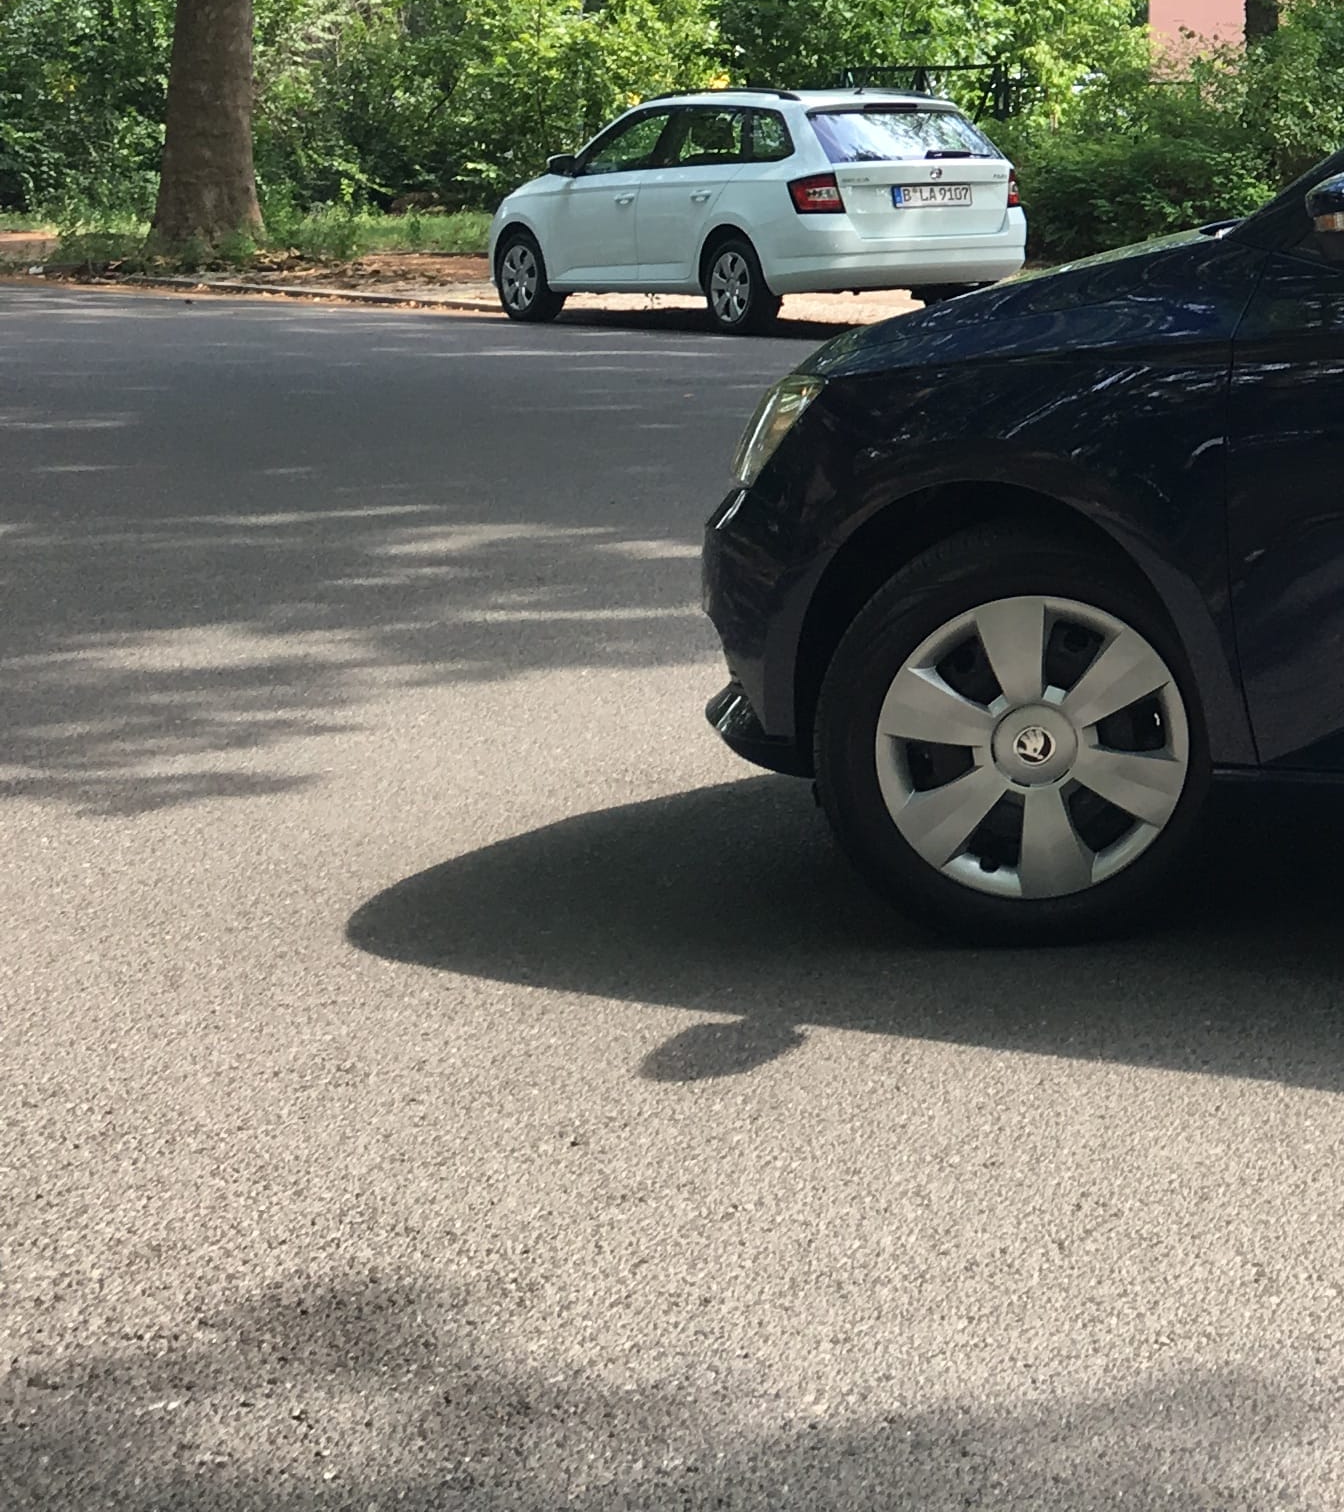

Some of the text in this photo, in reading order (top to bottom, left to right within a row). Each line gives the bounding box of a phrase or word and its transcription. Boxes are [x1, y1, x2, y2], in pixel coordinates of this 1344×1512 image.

[902, 187, 969, 202] B LA 9107
